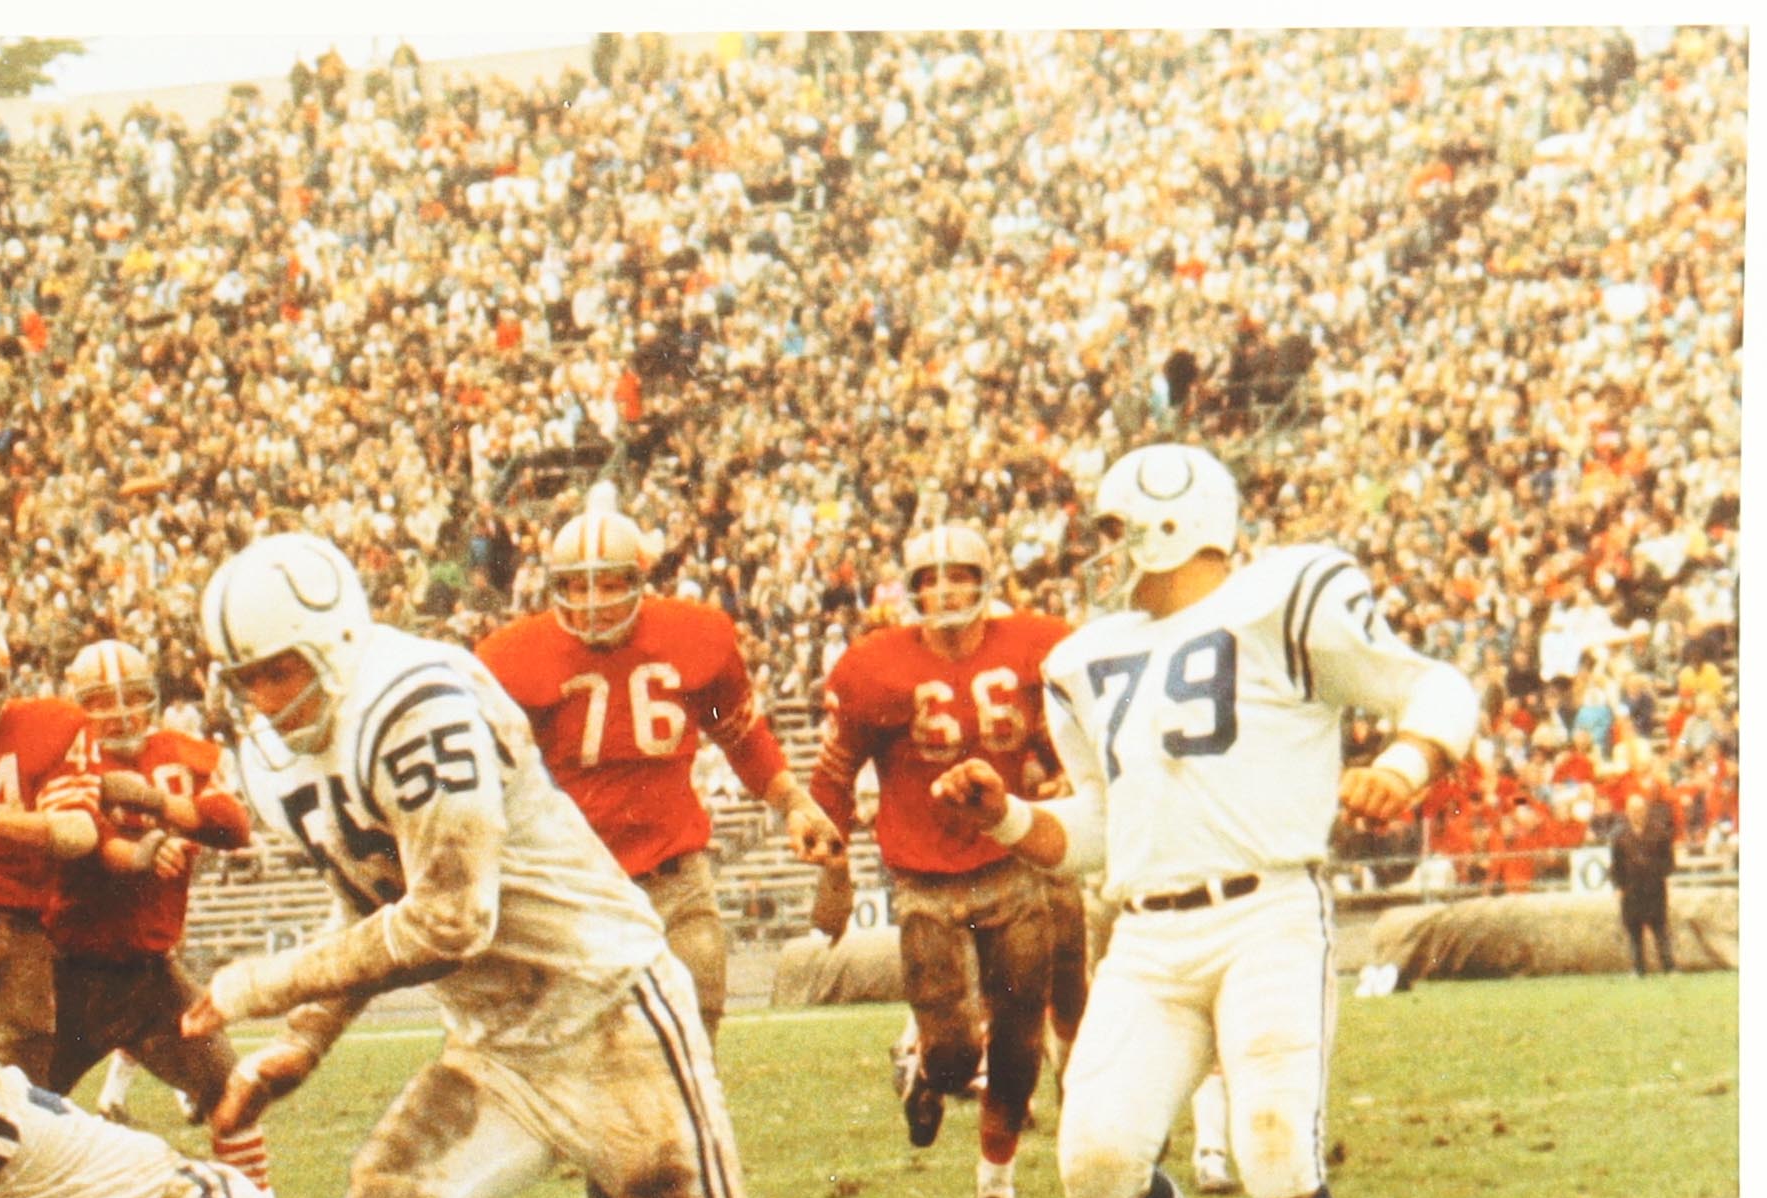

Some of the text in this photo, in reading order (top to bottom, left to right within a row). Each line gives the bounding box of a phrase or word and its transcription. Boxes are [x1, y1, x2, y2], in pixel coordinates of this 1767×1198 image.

[560, 662, 687, 768] 76
[911, 666, 1026, 762] 66
[1086, 628, 1238, 784] 79
[382, 722, 478, 811] 55
